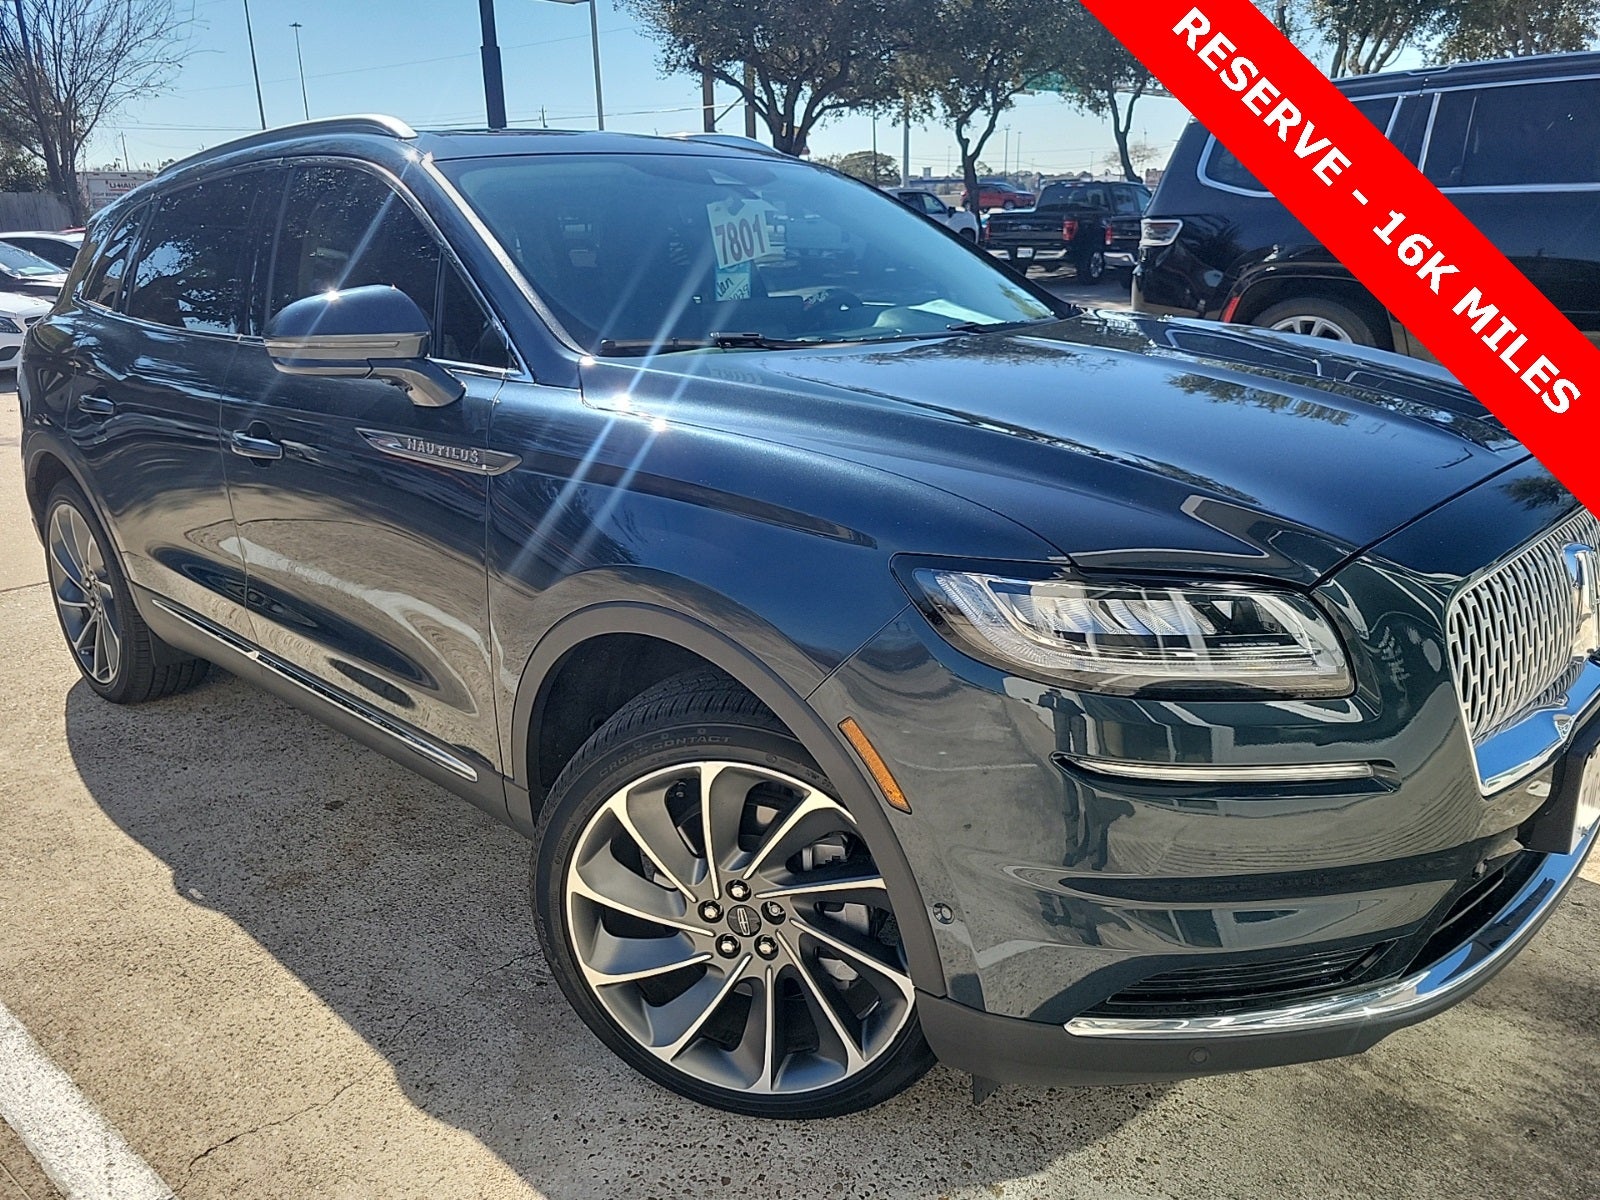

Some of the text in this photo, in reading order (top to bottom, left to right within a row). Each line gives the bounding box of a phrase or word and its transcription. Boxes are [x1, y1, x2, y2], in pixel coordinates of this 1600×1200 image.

[714, 214, 765, 265] 7801
[407, 438, 479, 464] NAUTILUS
[652, 736, 732, 750] CONTACT
